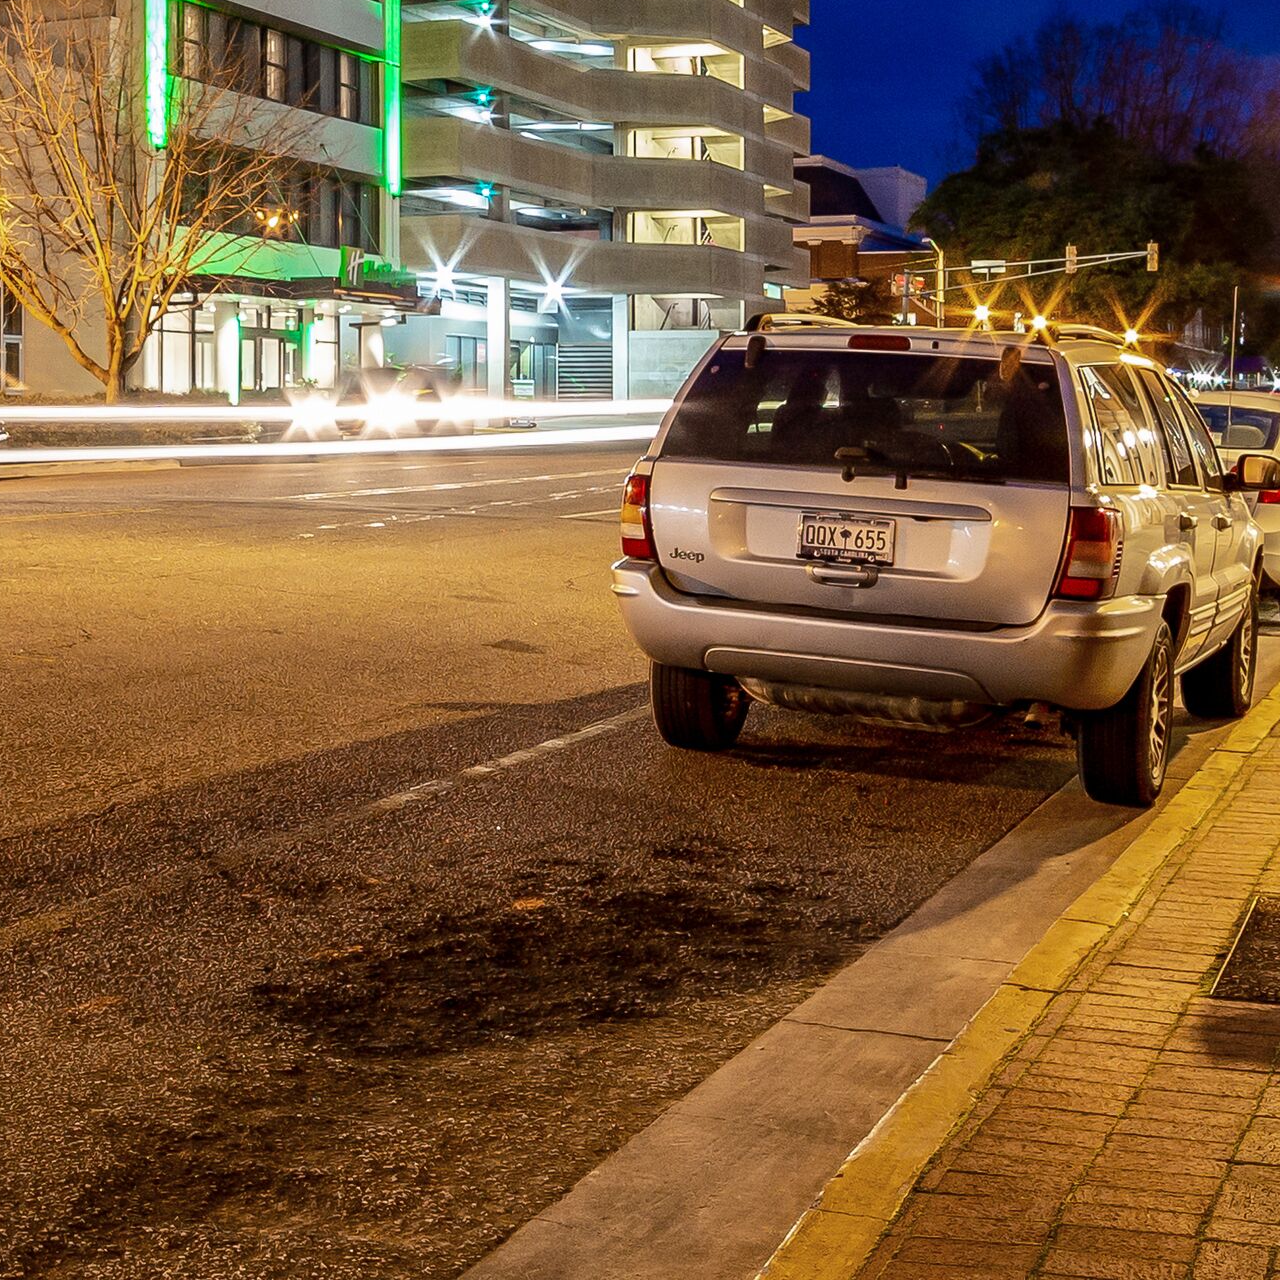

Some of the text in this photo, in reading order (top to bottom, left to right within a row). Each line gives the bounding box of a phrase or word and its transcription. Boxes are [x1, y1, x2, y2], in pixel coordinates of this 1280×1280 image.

[806, 524, 886, 551] QQX 655
[669, 547, 705, 563] Jeep
[840, 550, 868, 558] CAROLINA
